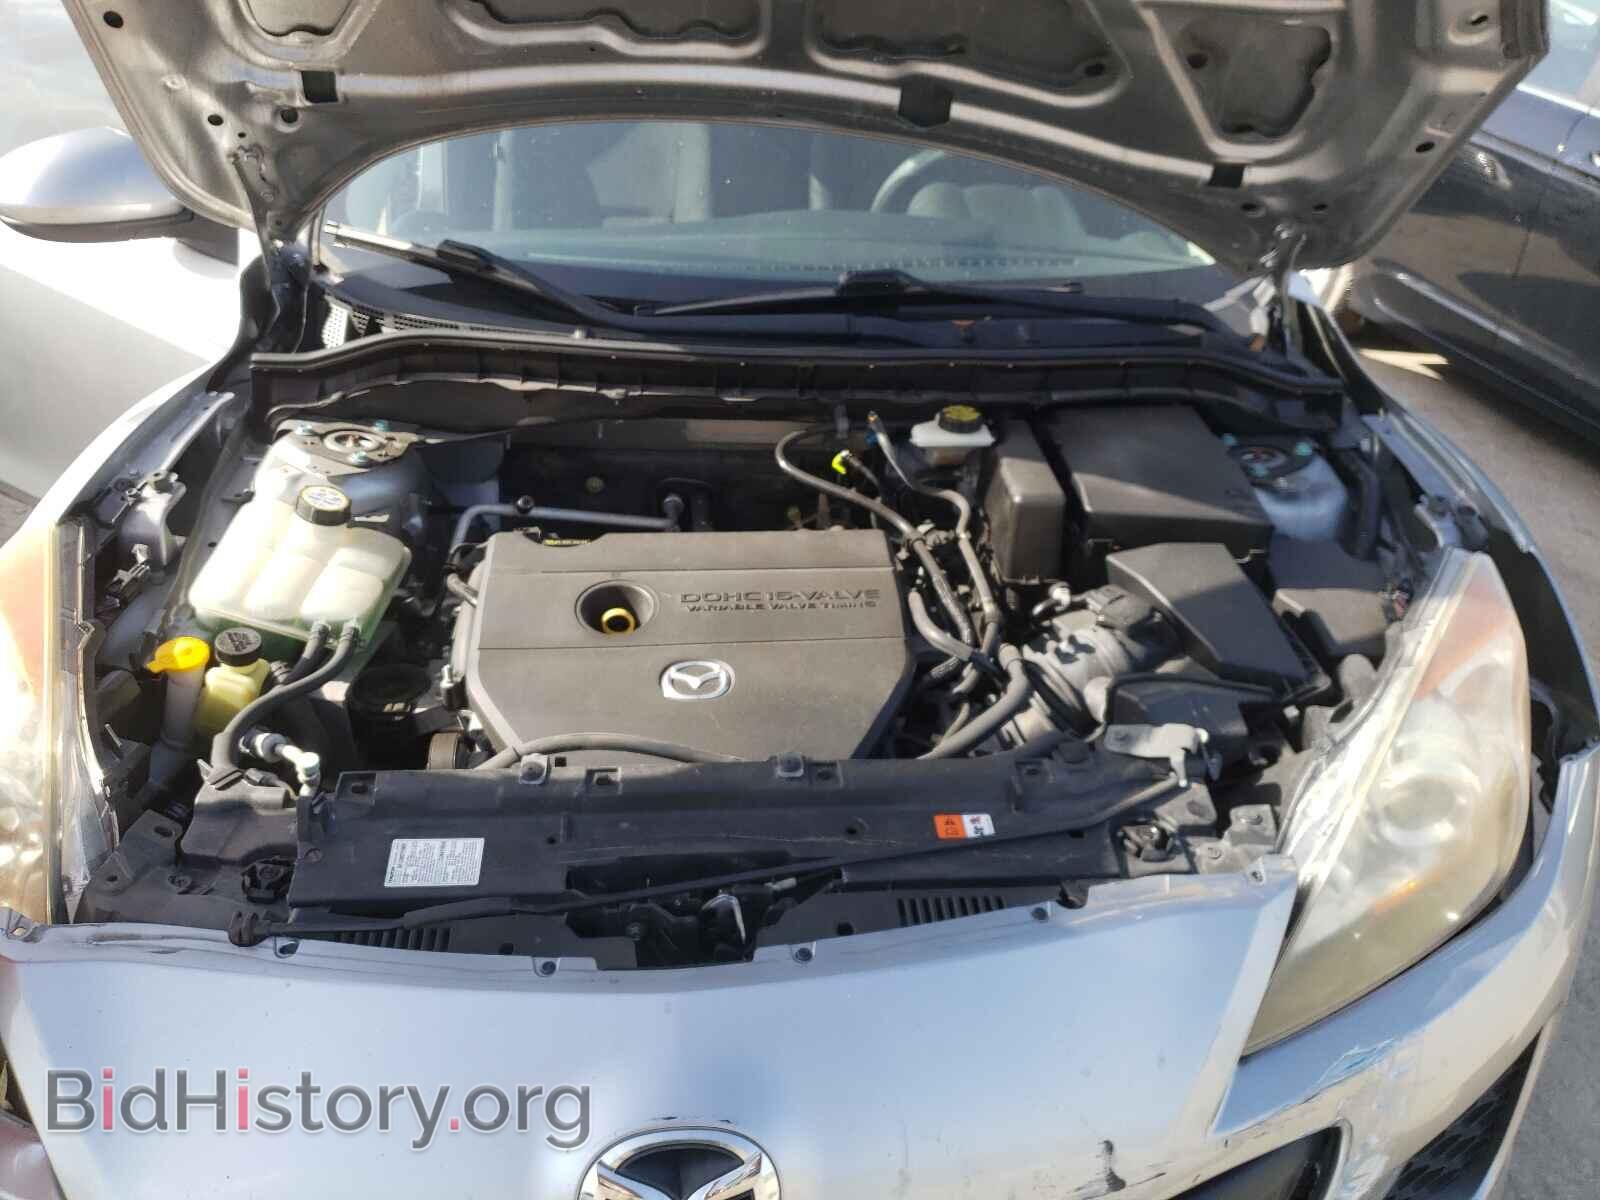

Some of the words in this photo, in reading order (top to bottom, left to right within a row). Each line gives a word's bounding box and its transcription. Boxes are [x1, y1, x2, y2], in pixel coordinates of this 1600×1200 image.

[681, 591, 761, 603] DOHC
[765, 588, 881, 602] 16-VALVE
[770, 602, 817, 611] VALVE
